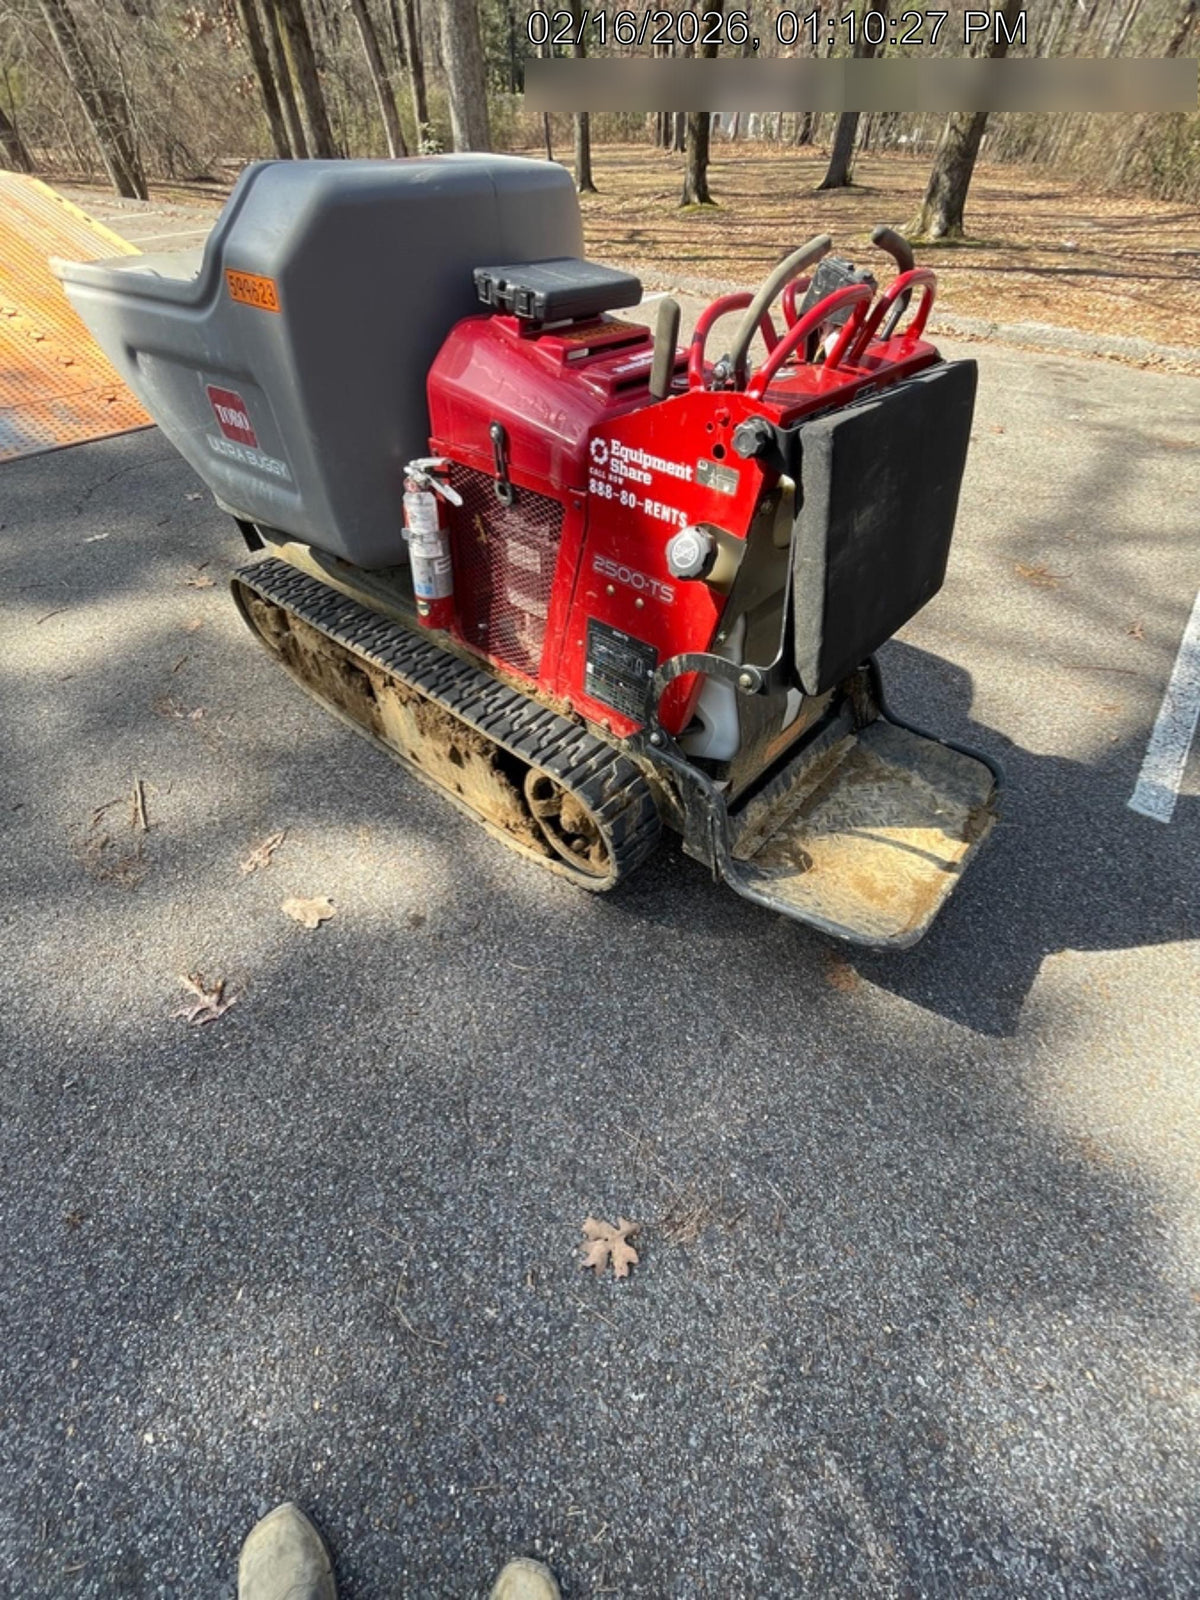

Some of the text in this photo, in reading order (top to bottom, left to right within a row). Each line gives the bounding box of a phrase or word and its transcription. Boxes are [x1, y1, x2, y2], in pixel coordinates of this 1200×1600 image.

[214, 402, 250, 431] TORO
[589, 466, 607, 480] CALL
[610, 438, 694, 483] Equipment
[610, 457, 653, 487] Share
[588, 478, 688, 529] 888-80-RENTS
